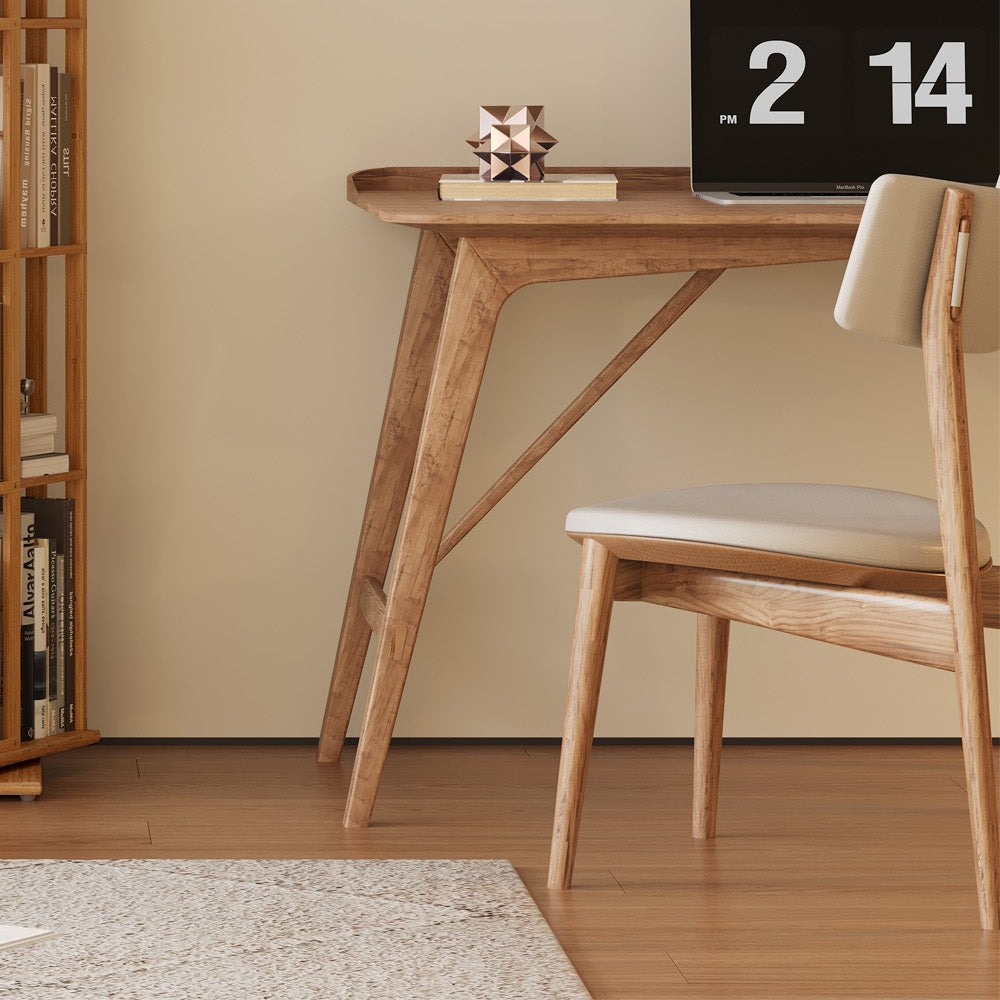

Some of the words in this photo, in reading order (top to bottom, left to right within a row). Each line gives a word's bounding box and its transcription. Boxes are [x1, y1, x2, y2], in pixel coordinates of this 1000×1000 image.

[719, 114, 738, 125] PM
[749, 40, 806, 125] 2
[869, 41, 973, 125] 14
